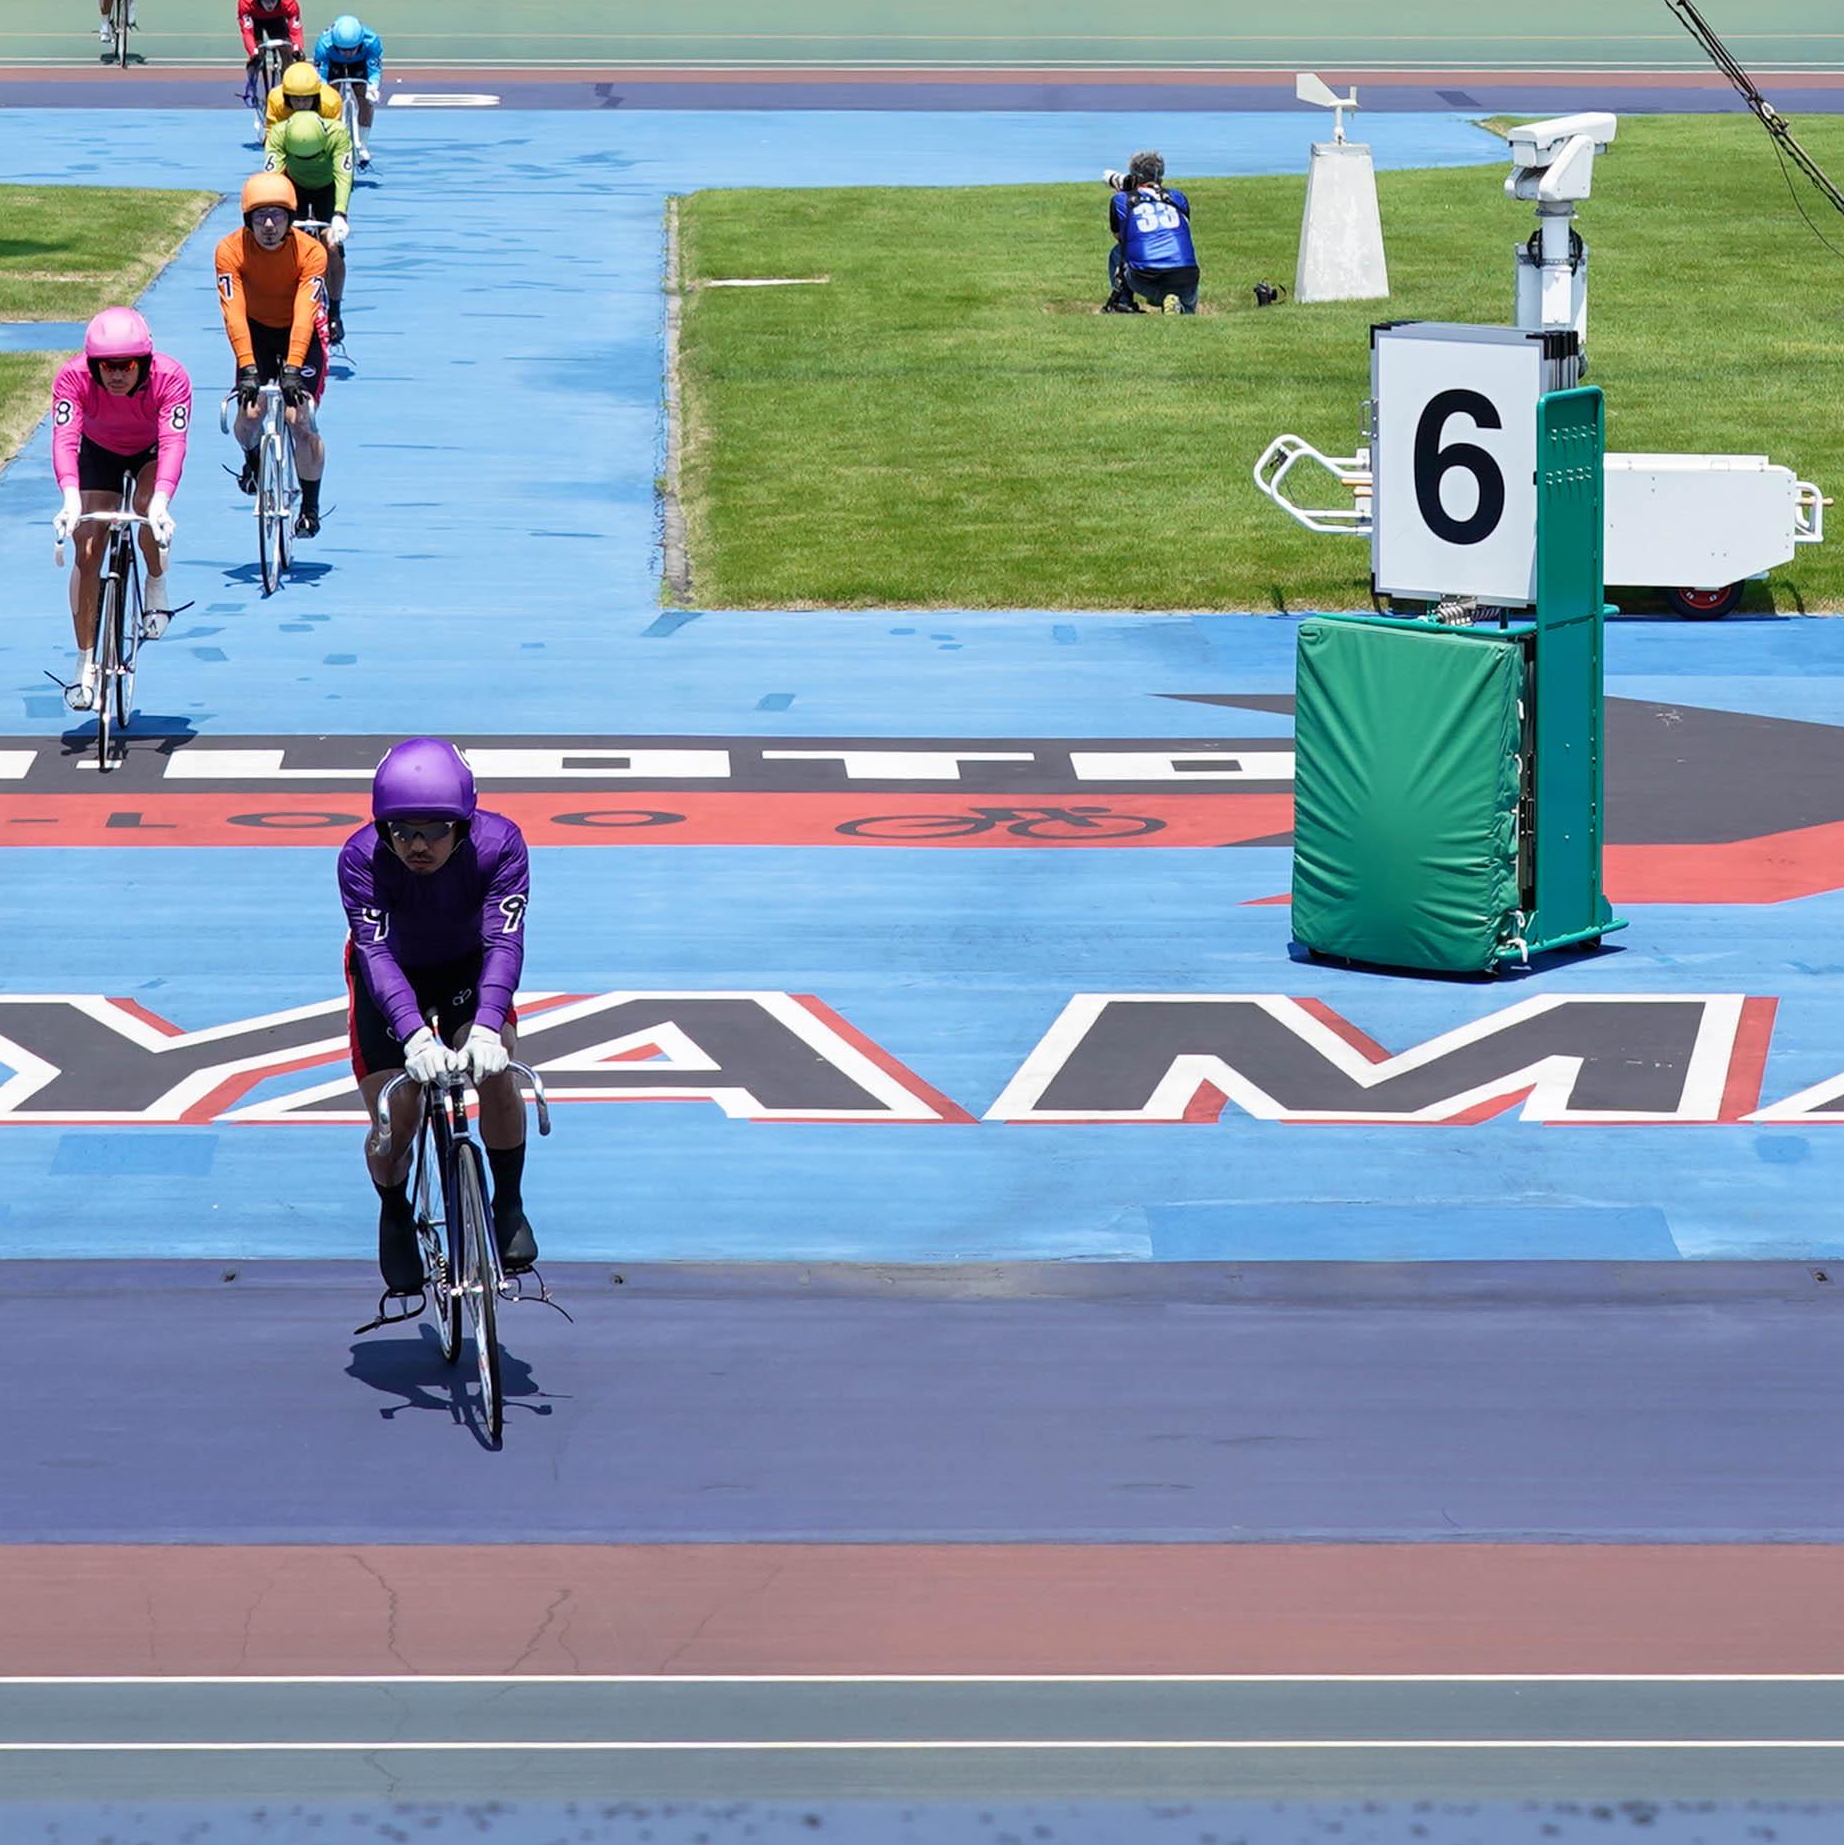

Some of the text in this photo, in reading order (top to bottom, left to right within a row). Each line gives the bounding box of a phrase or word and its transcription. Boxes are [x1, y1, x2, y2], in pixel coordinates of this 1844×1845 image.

[1133, 202, 1180, 233] 33
[219, 273, 234, 299] 7
[54, 400, 72, 428] 8
[171, 406, 187, 431] 8
[1413, 387, 1506, 546] 6
[500, 894, 527, 934] 9
